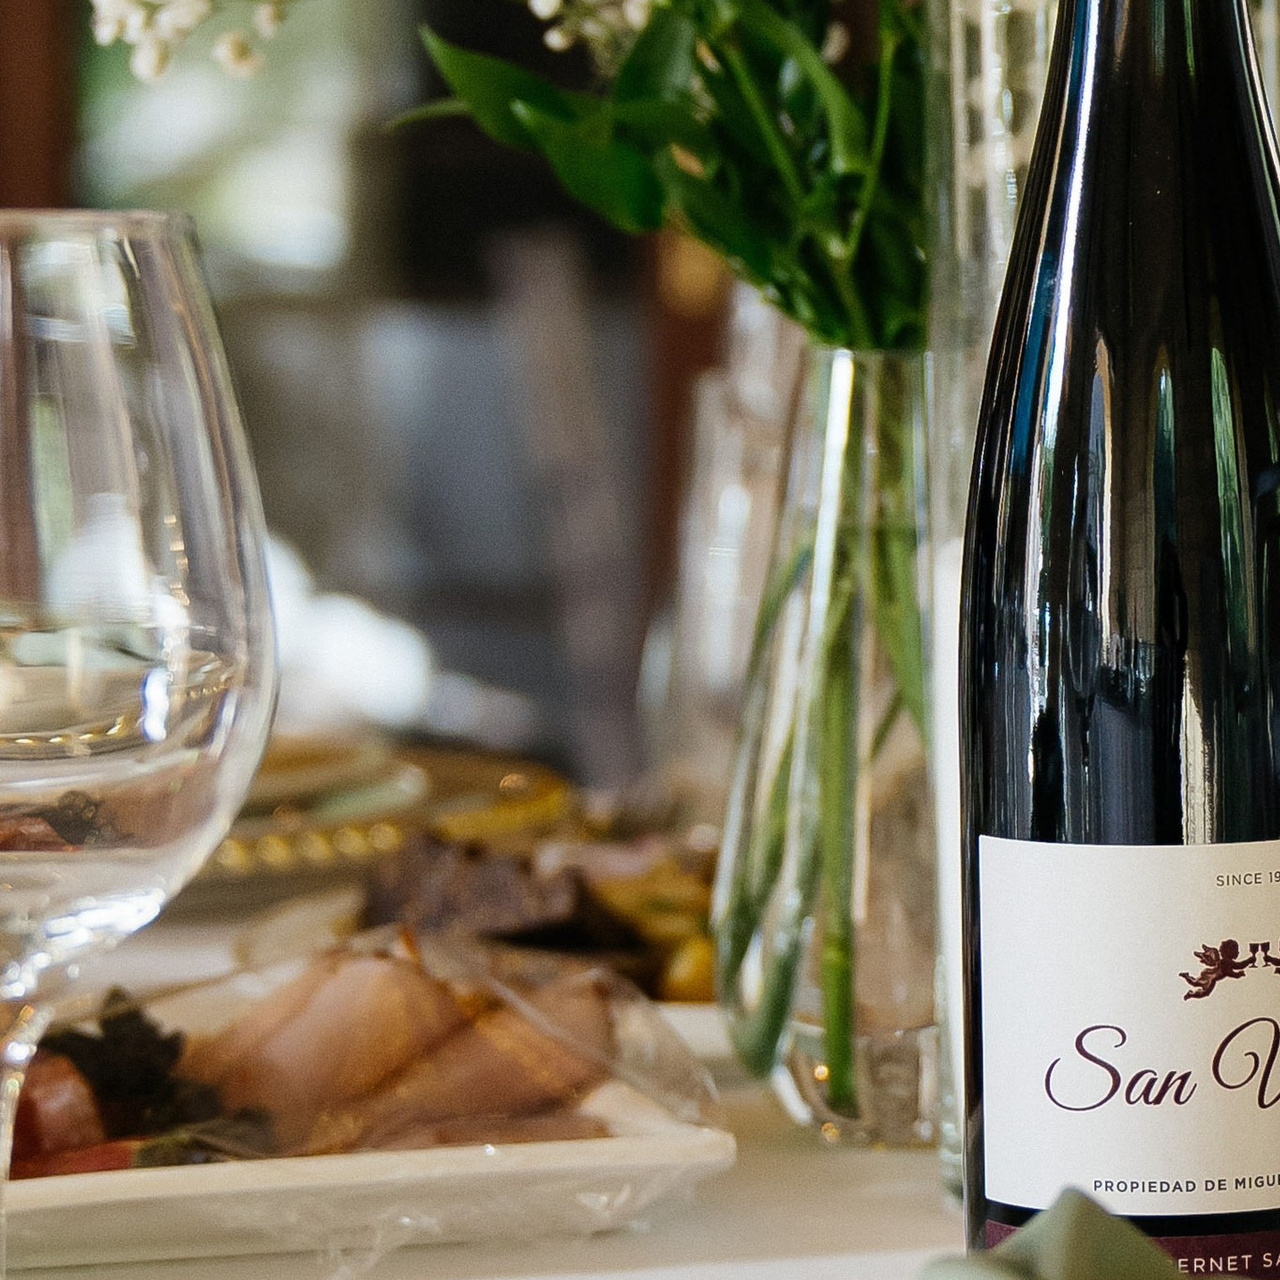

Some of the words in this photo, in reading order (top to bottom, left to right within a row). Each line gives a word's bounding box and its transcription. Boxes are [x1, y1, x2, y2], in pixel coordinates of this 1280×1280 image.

[1215, 872, 1263, 887] SINCE
[1044, 1024, 1198, 1112] San
[1093, 1179, 1197, 1193] PROPIEDAD
[1204, 1178, 1228, 1192] DE
